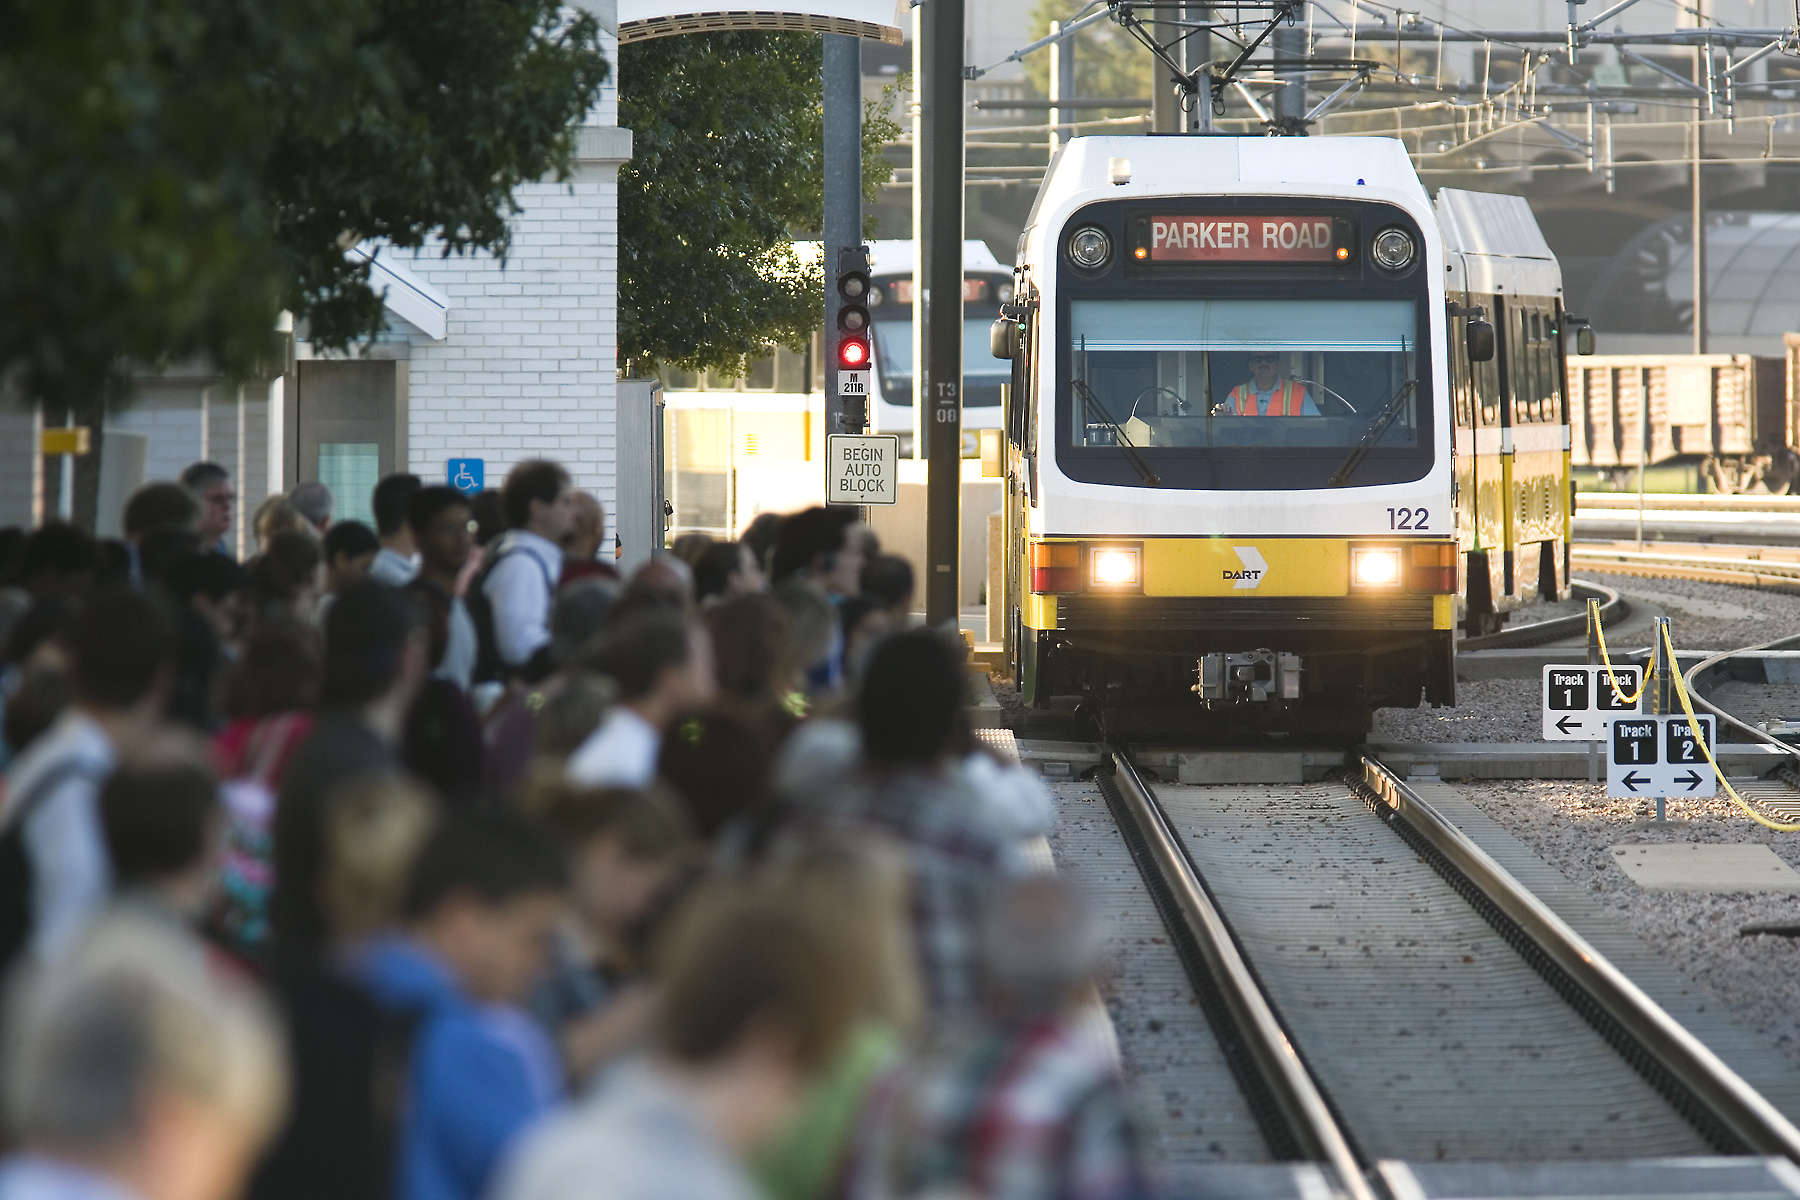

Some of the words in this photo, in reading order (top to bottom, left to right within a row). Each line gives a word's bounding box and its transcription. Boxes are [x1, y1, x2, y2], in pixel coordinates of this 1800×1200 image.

[1152, 222, 1249, 248] PARKER
[1262, 222, 1331, 249] ROAD
[850, 373, 858, 382] M
[844, 383, 864, 393] 211R
[937, 382, 956, 397] T3
[843, 448, 883, 461] BEGIN
[845, 464, 881, 476] AUTO
[840, 479, 885, 492] BLOCK
[1387, 508, 1430, 530] 122
[1222, 570, 1261, 580] DART
[1553, 674, 1584, 686] Track
[1563, 689, 1572, 707] 1
[1611, 689, 1622, 707] 2
[1619, 724, 1652, 738] Track
[1630, 742, 1639, 761] 1
[1682, 741, 1694, 760] 2
